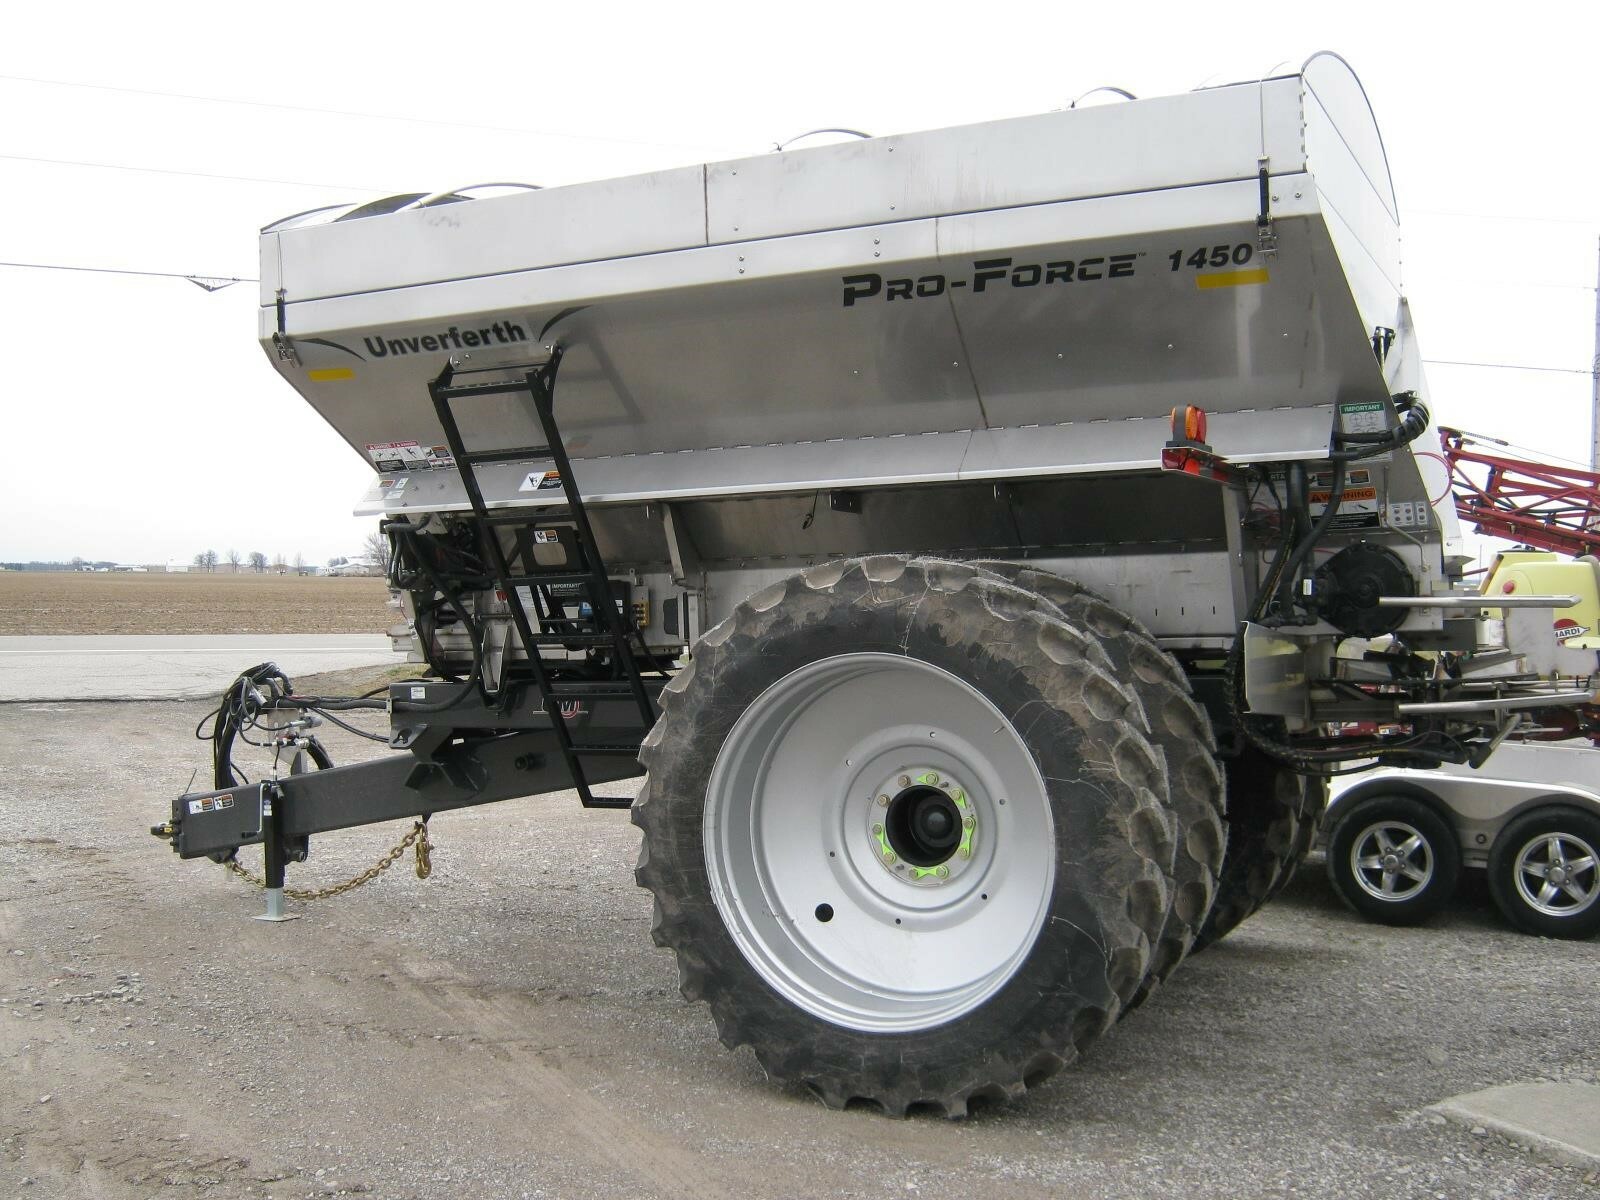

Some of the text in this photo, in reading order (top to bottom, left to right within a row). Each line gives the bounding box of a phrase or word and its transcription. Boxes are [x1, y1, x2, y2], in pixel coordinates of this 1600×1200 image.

[1169, 242, 1253, 272] 1450
[363, 320, 527, 358] Unverferth
[1344, 403, 1380, 413] IMPORTANT
